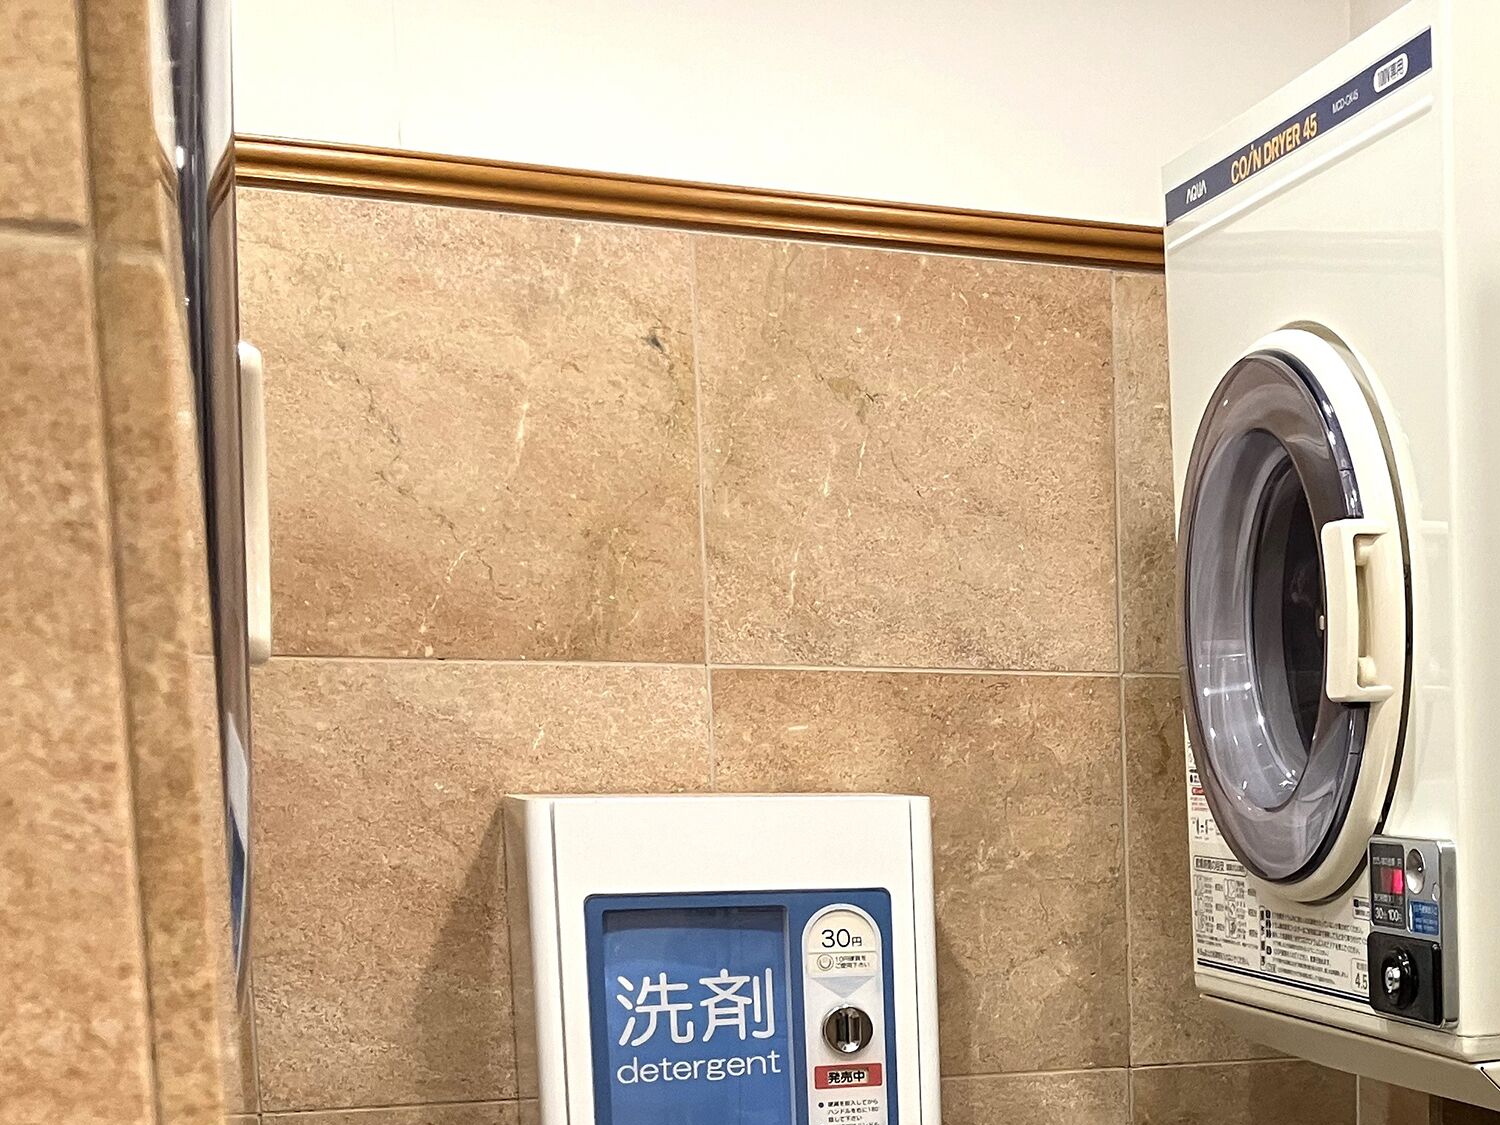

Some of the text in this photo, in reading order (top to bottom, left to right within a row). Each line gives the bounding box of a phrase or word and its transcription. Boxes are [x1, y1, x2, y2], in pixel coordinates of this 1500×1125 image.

[1186, 179, 1207, 205] AQUA
[1263, 122, 1300, 166] DRYER
[1302, 112, 1318, 139] 45
[821, 928, 862, 948] 30円
[616, 967, 776, 1047] 洗剤
[616, 1050, 781, 1084] detergent
[828, 1070, 865, 1084] 発売中
